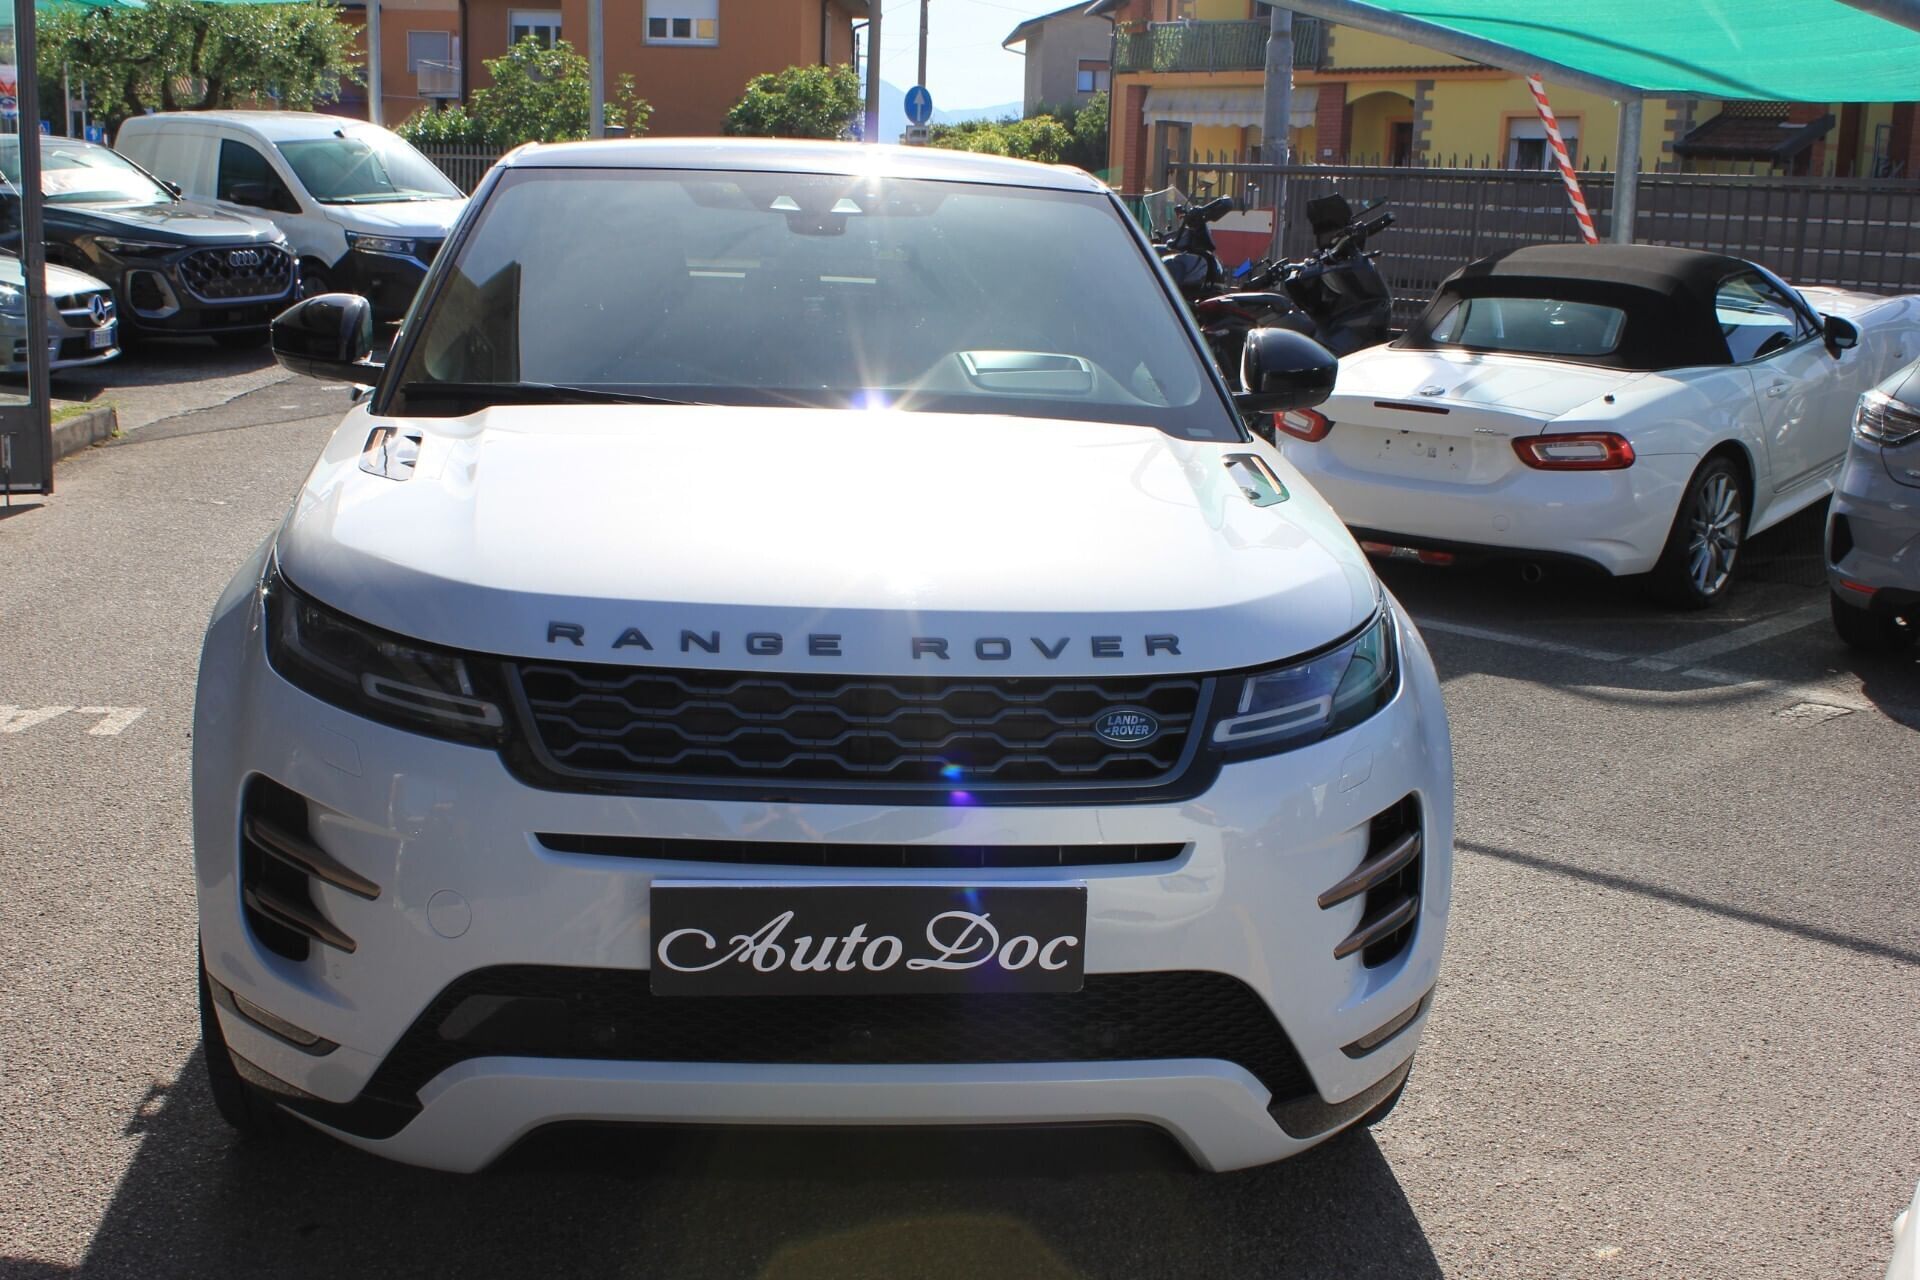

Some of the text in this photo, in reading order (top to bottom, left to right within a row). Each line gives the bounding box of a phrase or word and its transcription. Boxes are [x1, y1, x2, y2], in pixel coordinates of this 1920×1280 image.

[547, 620, 1182, 661] RANGE ROVER
[1107, 715, 1139, 726] LAND
[1111, 725, 1149, 736] ROVER
[657, 910, 1079, 973] Auto Doc
